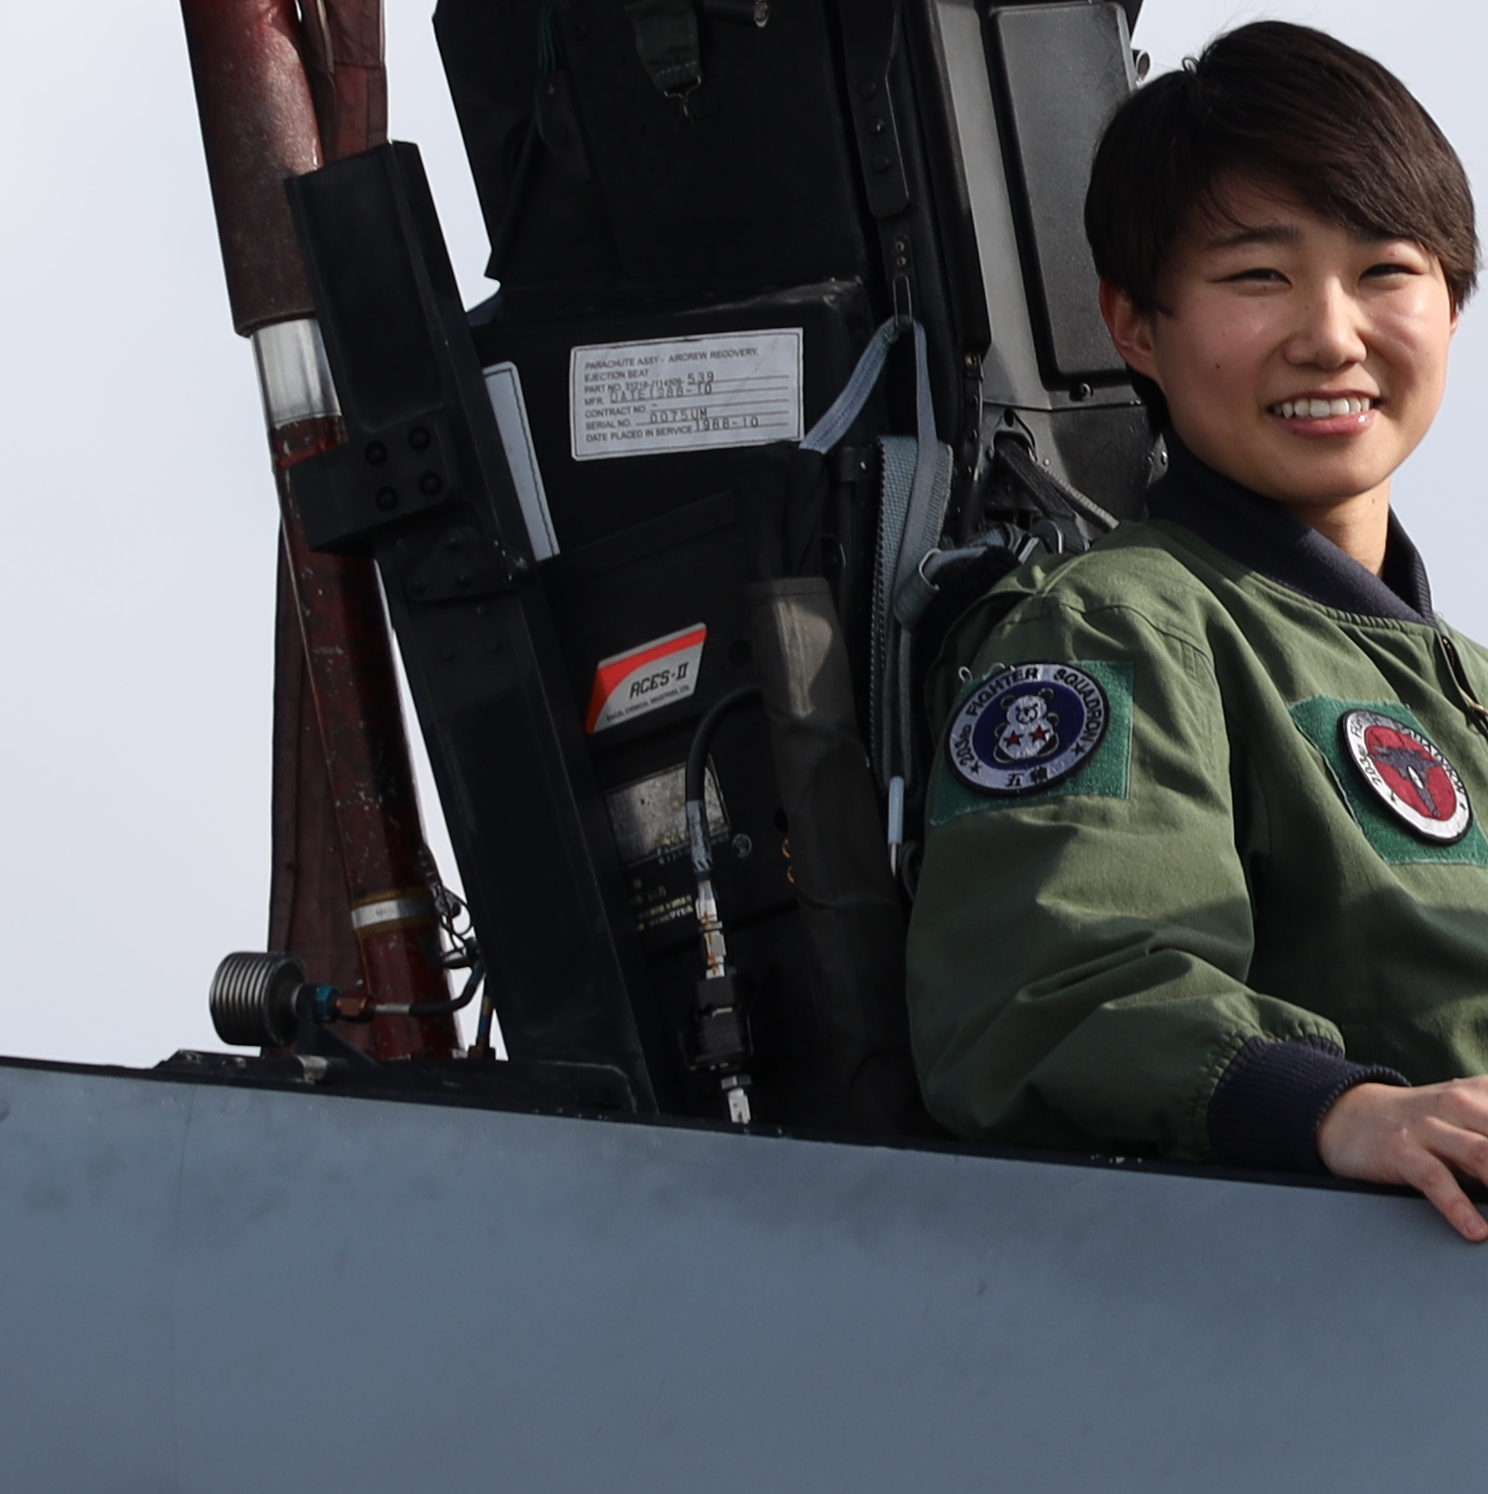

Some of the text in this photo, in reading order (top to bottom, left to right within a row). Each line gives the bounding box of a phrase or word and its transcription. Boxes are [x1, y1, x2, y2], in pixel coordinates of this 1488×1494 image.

[585, 357, 635, 370] PARACHUTE
[668, 351, 707, 364] AIRCREW
[584, 370, 625, 382] EJECTION
[584, 383, 606, 394] PART
[585, 406, 632, 418] CONTRACT
[586, 420, 616, 431] SERIAL
[586, 433, 607, 443] DATE
[610, 429, 643, 440] PLACED
[645, 427, 654, 437] IN
[656, 425, 693, 437] SERVICE
[966, 667, 1038, 717] FIGHTER
[1053, 668, 1102, 743] SQUADRON
